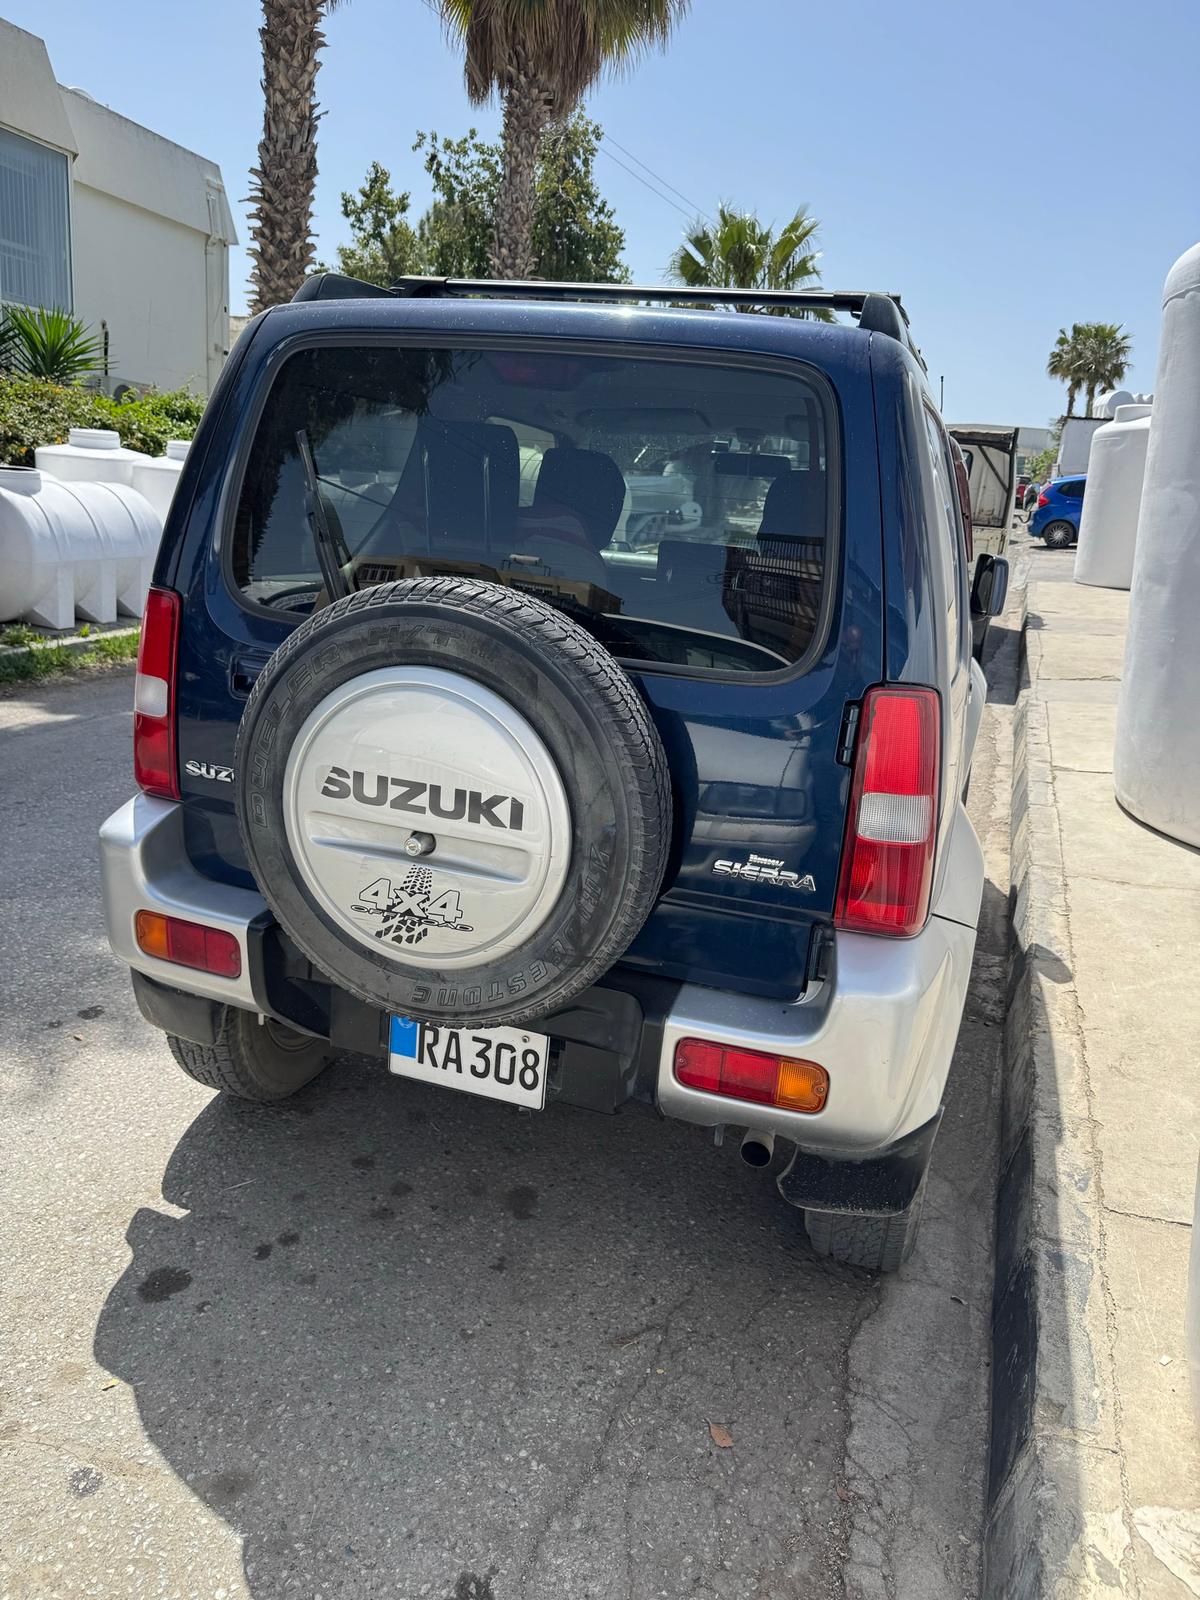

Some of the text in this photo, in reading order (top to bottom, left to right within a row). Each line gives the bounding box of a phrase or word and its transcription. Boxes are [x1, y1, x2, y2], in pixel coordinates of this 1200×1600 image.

[185, 760, 235, 783] SUZ
[321, 766, 524, 831] SUZUKI
[711, 860, 816, 891] SIERRA
